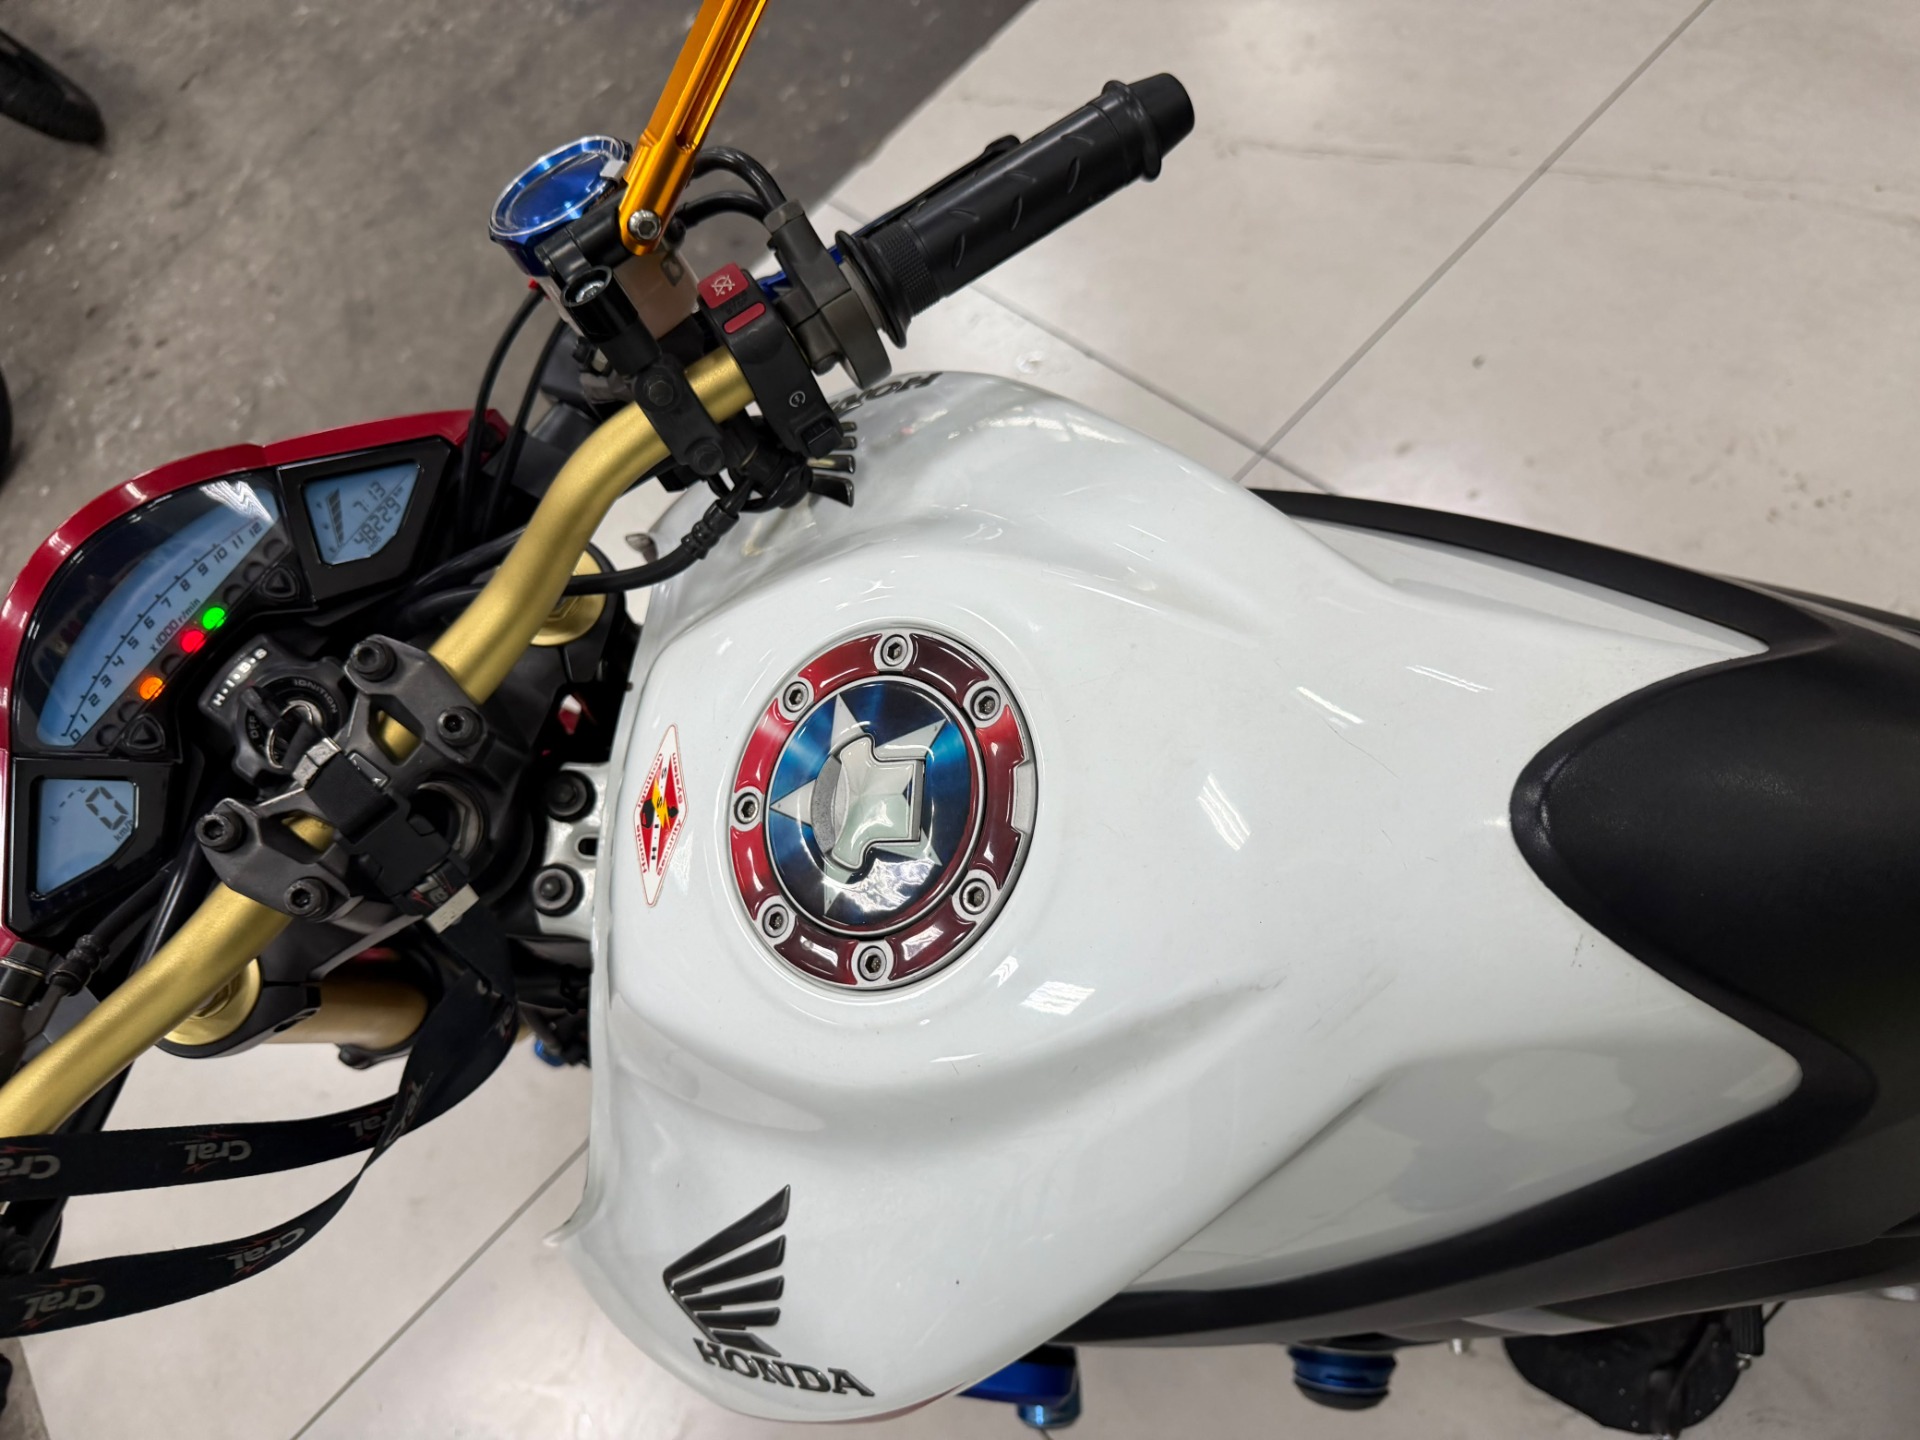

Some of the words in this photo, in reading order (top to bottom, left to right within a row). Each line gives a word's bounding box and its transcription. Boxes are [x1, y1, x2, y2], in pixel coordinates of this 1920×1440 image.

[353, 481, 386, 513] 7:13
[353, 496, 402, 546] 48229
[69, 729, 81, 742] 0
[80, 713, 88, 723] 1
[88, 693, 101, 707] 2
[100, 674, 112, 688] 3
[112, 655, 125, 667] 4
[127, 636, 140, 650] 5
[143, 616, 155, 630] 6
[160, 597, 172, 608] 7
[180, 579, 191, 592] 8
[197, 562, 209, 576] 9
[213, 547, 228, 563] 10
[232, 535, 244, 549] 11
[249, 522, 262, 538] 12
[294, 679, 338, 713] IGNITION
[248, 715, 260, 739] OFF
[637, 752, 664, 808] Ignition
[85, 786, 129, 830] 0
[656, 819, 682, 877] Security
[672, 752, 684, 804] System
[636, 824, 648, 874] Honda
[692, 1337, 875, 1397] HONDA
